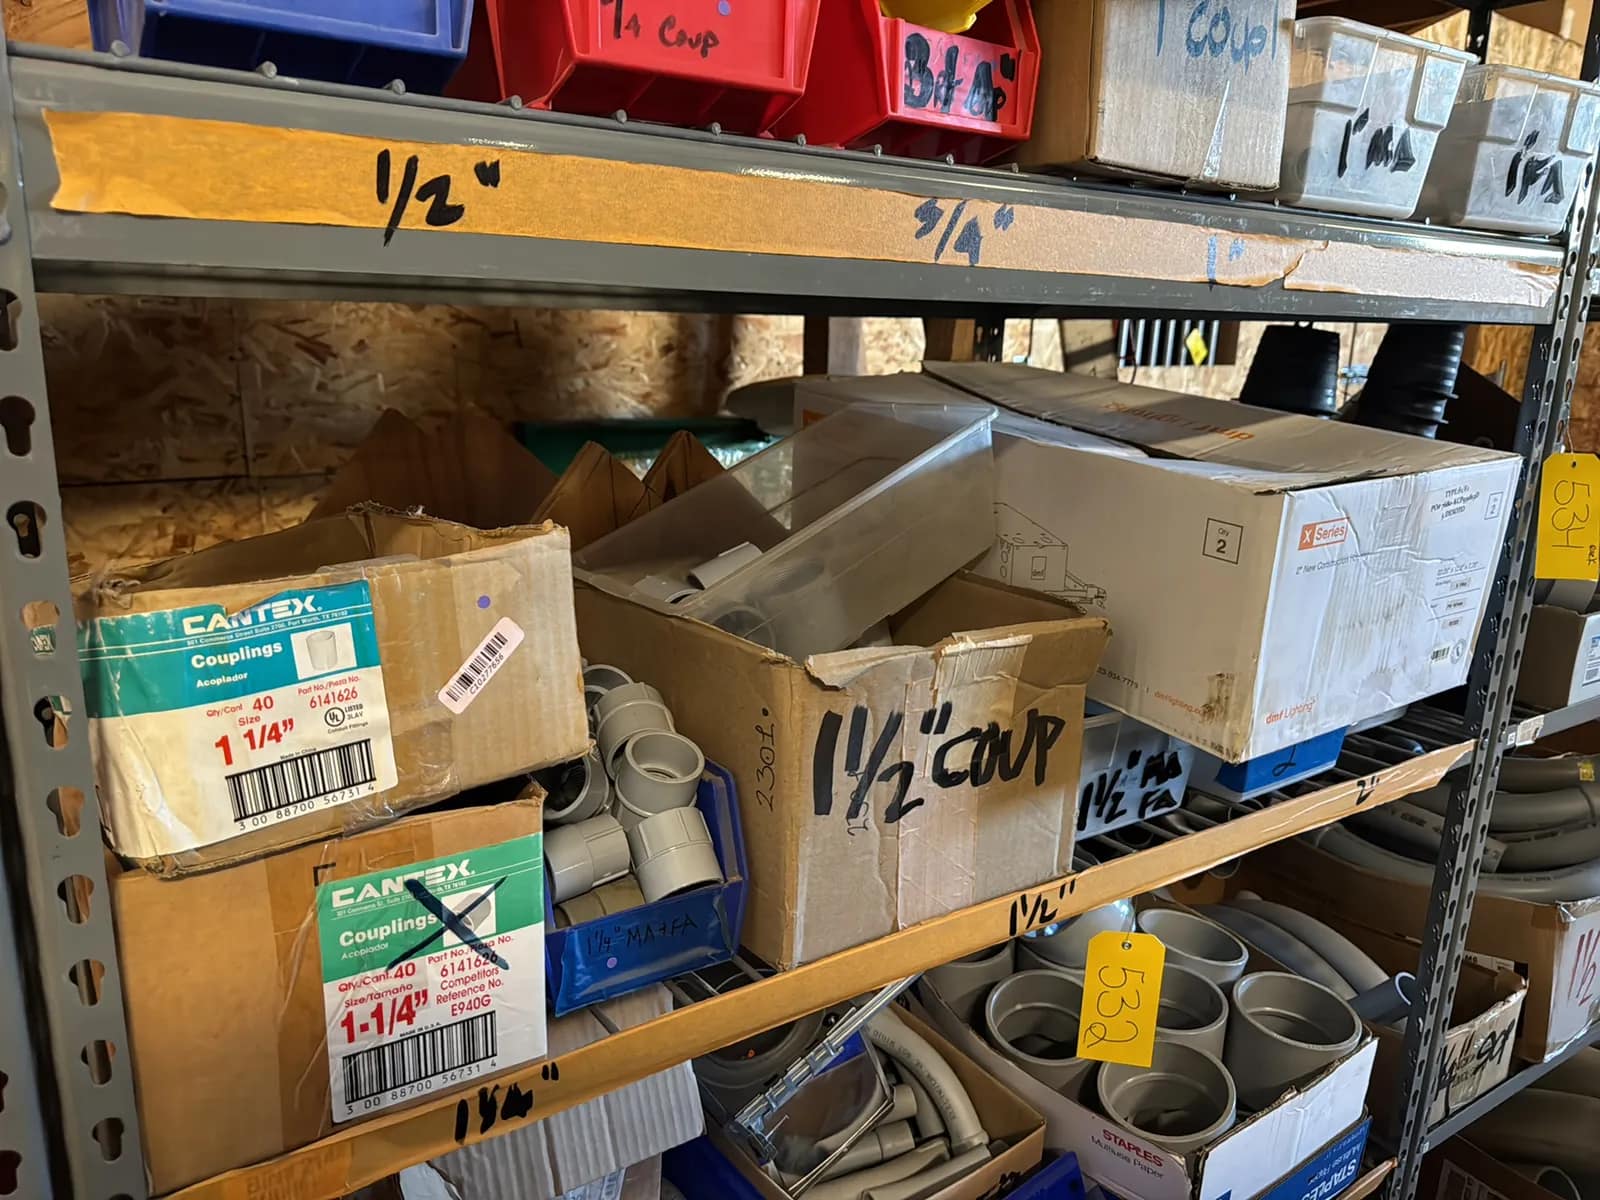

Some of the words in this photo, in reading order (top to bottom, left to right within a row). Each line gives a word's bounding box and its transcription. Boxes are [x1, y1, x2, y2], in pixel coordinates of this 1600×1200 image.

[659, 15, 719, 58] Coup
[1552, 480, 1590, 548] 534
[1315, 524, 1345, 541] Series
[1216, 539, 1227, 554] 2
[1303, 563, 1316, 574] New
[182, 594, 318, 636] CANTEX
[191, 642, 283, 668] Couplings
[196, 671, 249, 688] Acoplador
[298, 685, 312, 696] Part
[348, 675, 360, 684] No.
[252, 695, 274, 711] 40
[309, 686, 358, 709] 6141626
[344, 703, 364, 715] LISTED
[238, 715, 261, 727] Size
[214, 735, 233, 766] 1
[243, 717, 294, 751] 1/4"
[931, 708, 1066, 789] COUP
[1356, 775, 1380, 806] 2"
[239, 821, 247, 831] 3
[252, 815, 268, 827] 00
[276, 801, 315, 820] 88700
[323, 787, 361, 806] 56731
[339, 914, 437, 947] Couplings
[342, 942, 389, 960] Acoplador
[428, 953, 447, 964] Part
[497, 935, 514, 946] No.
[393, 962, 416, 979] 40
[440, 952, 498, 978] 6141626
[436, 984, 486, 1005] Reference
[488, 979, 504, 989] No.
[440, 967, 500, 991] Competitors
[344, 983, 413, 1009] Size/Tamaño
[451, 994, 492, 1017] E940G
[1083, 965, 1145, 1048] 532
[346, 1105, 354, 1116] 3
[364, 1096, 381, 1109] 00
[391, 1080, 432, 1101] 88700
[442, 1064, 482, 1084] 56731
[490, 1058, 497, 1069] 4
[1091, 1135, 1131, 1163] Multiuse
[1133, 1159, 1164, 1179] Paper
[1102, 1128, 1164, 1167] STAPLES
